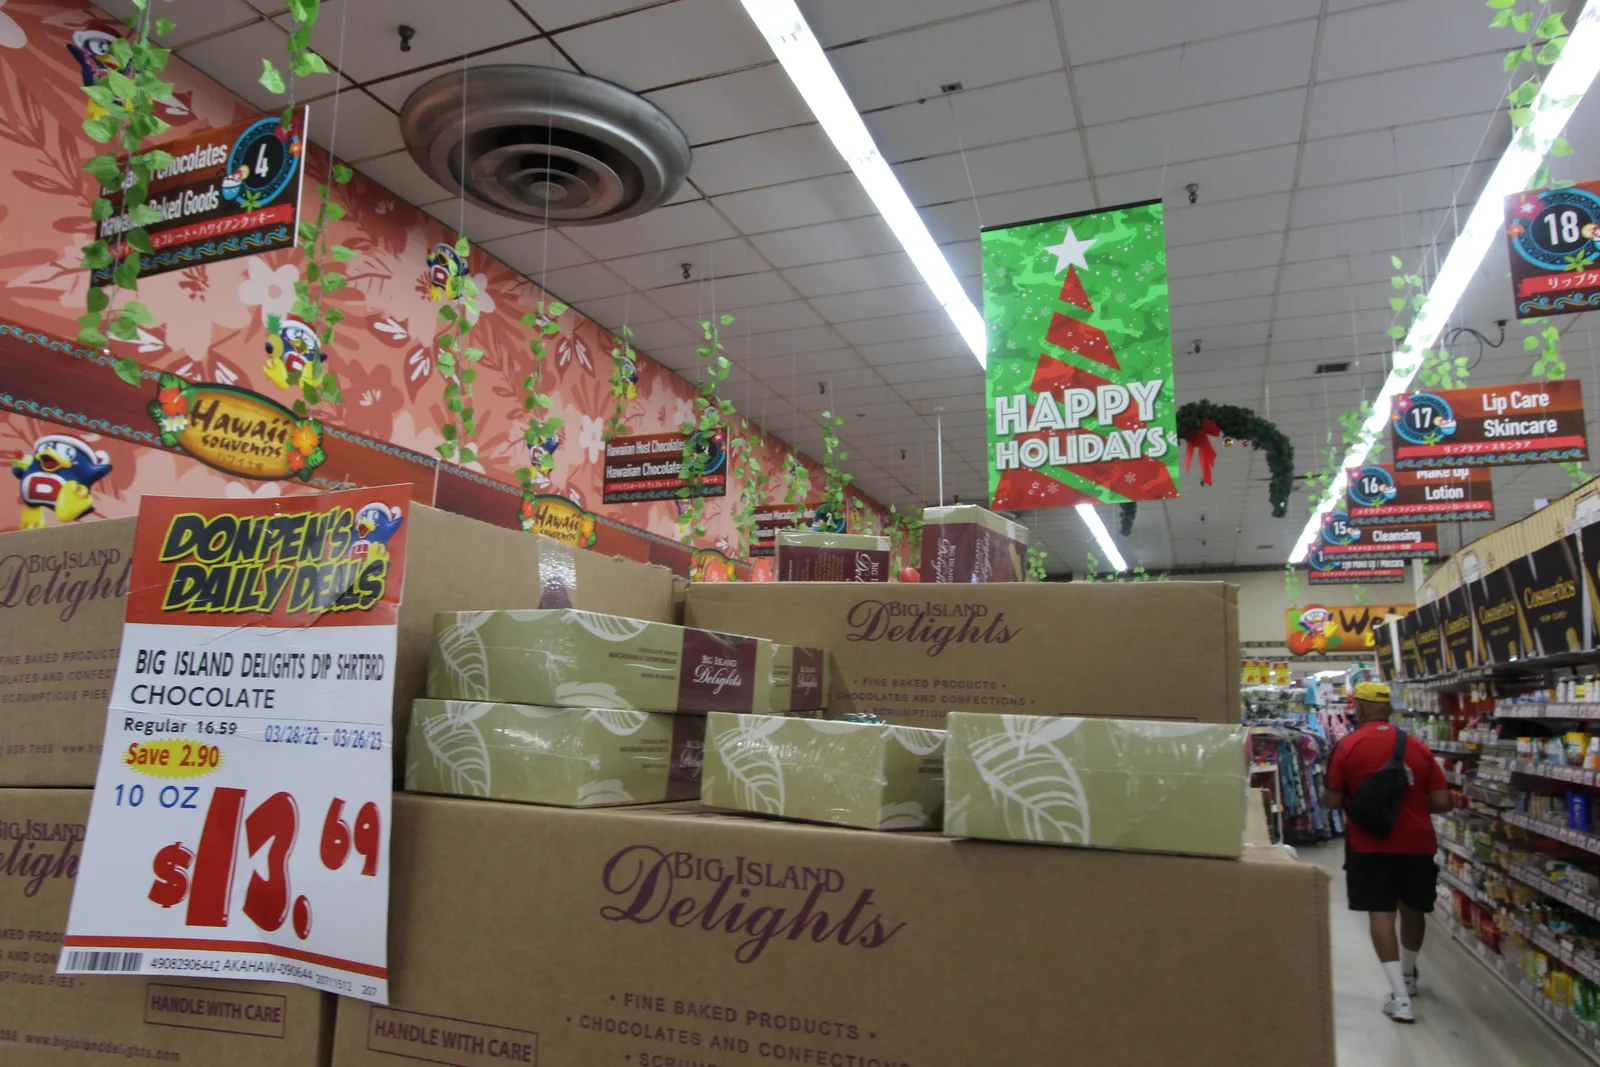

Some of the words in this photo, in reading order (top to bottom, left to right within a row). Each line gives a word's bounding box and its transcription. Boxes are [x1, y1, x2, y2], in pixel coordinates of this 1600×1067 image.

[254, 143, 270, 178] 4
[184, 185, 220, 216] Goods
[1543, 210, 1580, 246] 18
[994, 379, 1164, 435] HAPPY
[1482, 393, 1507, 415] Lip
[1510, 390, 1549, 410] Care
[190, 399, 288, 444] Hawaii
[1411, 407, 1433, 429] 17
[1483, 417, 1558, 438] Skincare
[606, 442, 635, 457] Hawaiian
[636, 441, 651, 454] Host
[652, 438, 685, 453] Chocolates
[995, 426, 1168, 471] HOLIDAYS
[606, 464, 641, 478] Hawaiian
[1361, 477, 1379, 494] 16
[1425, 485, 1464, 501] Lotion
[159, 506, 353, 563] DONPEN'S
[1333, 521, 1347, 535] 15
[1372, 529, 1422, 543] Cleansing
[28, 554, 57, 573] BIG
[63, 548, 121, 570] ISLAND
[0, 554, 133, 622] Delight
[161, 560, 293, 613] DAILY
[286, 557, 388, 614] DEALS
[889, 601, 920, 617] BIG
[926, 601, 988, 617] ISLAND
[846, 599, 1023, 657] Delights
[135, 649, 166, 675] BIG
[174, 650, 234, 677] ISLAND
[241, 652, 306, 679] DELIGHTS
[311, 653, 331, 680] DIP
[336, 653, 385, 681] SHRTBRD
[702, 654, 714, 665] BIG
[714, 655, 738, 667] ISLAND
[0, 673, 38, 685] OLATES
[42, 671, 64, 682] AND
[67, 668, 117, 681] CONFECT
[692, 664, 743, 694] Delights
[862, 677, 888, 687] FINE
[892, 678, 929, 688] BAKED
[934, 679, 998, 690] PRODUCTS
[83, 688, 108, 700] PIES
[130, 684, 276, 709] CHOCOLATE
[836, 692, 909, 703] CHOCOLATES
[914, 694, 935, 704] AND
[941, 695, 1026, 706] CONFECTIONS
[872, 707, 951, 718] SCRUMPTIOU
[124, 717, 186, 735] Regular
[197, 721, 238, 735] 16.59
[264, 724, 319, 745] 03/28/22
[332, 728, 383, 751] 03/26/23
[126, 743, 170, 766] Save
[178, 744, 220, 768] 2.90
[114, 784, 145, 808] 10
[159, 785, 200, 809] OZ
[25, 819, 86, 842] ISLAND
[673, 851, 725, 883] BIG
[735, 856, 845, 893] ISLAND
[600, 844, 908, 964] Delights
[28, 930, 65, 944] PRODU
[50, 975, 76, 988] PIES
[222, 958, 314, 981] AKAHAW-090644
[361, 984, 378, 997] 207
[150, 994, 204, 1016] HANDLE
[207, 1000, 242, 1021] WITH
[244, 1004, 282, 1024] CARE
[623, 993, 667, 1012] FINE
[674, 1000, 738, 1023] BAKED
[745, 1010, 860, 1040] PRODUCTS
[375, 1018, 439, 1046] HANDLE
[441, 1030, 485, 1054] WITH
[487, 1038, 533, 1063] CARE
[579, 1014, 701, 1047] CHOCOLATES
[709, 1035, 750, 1054] AND
[758, 1041, 912, 1067] CONFECTIO
